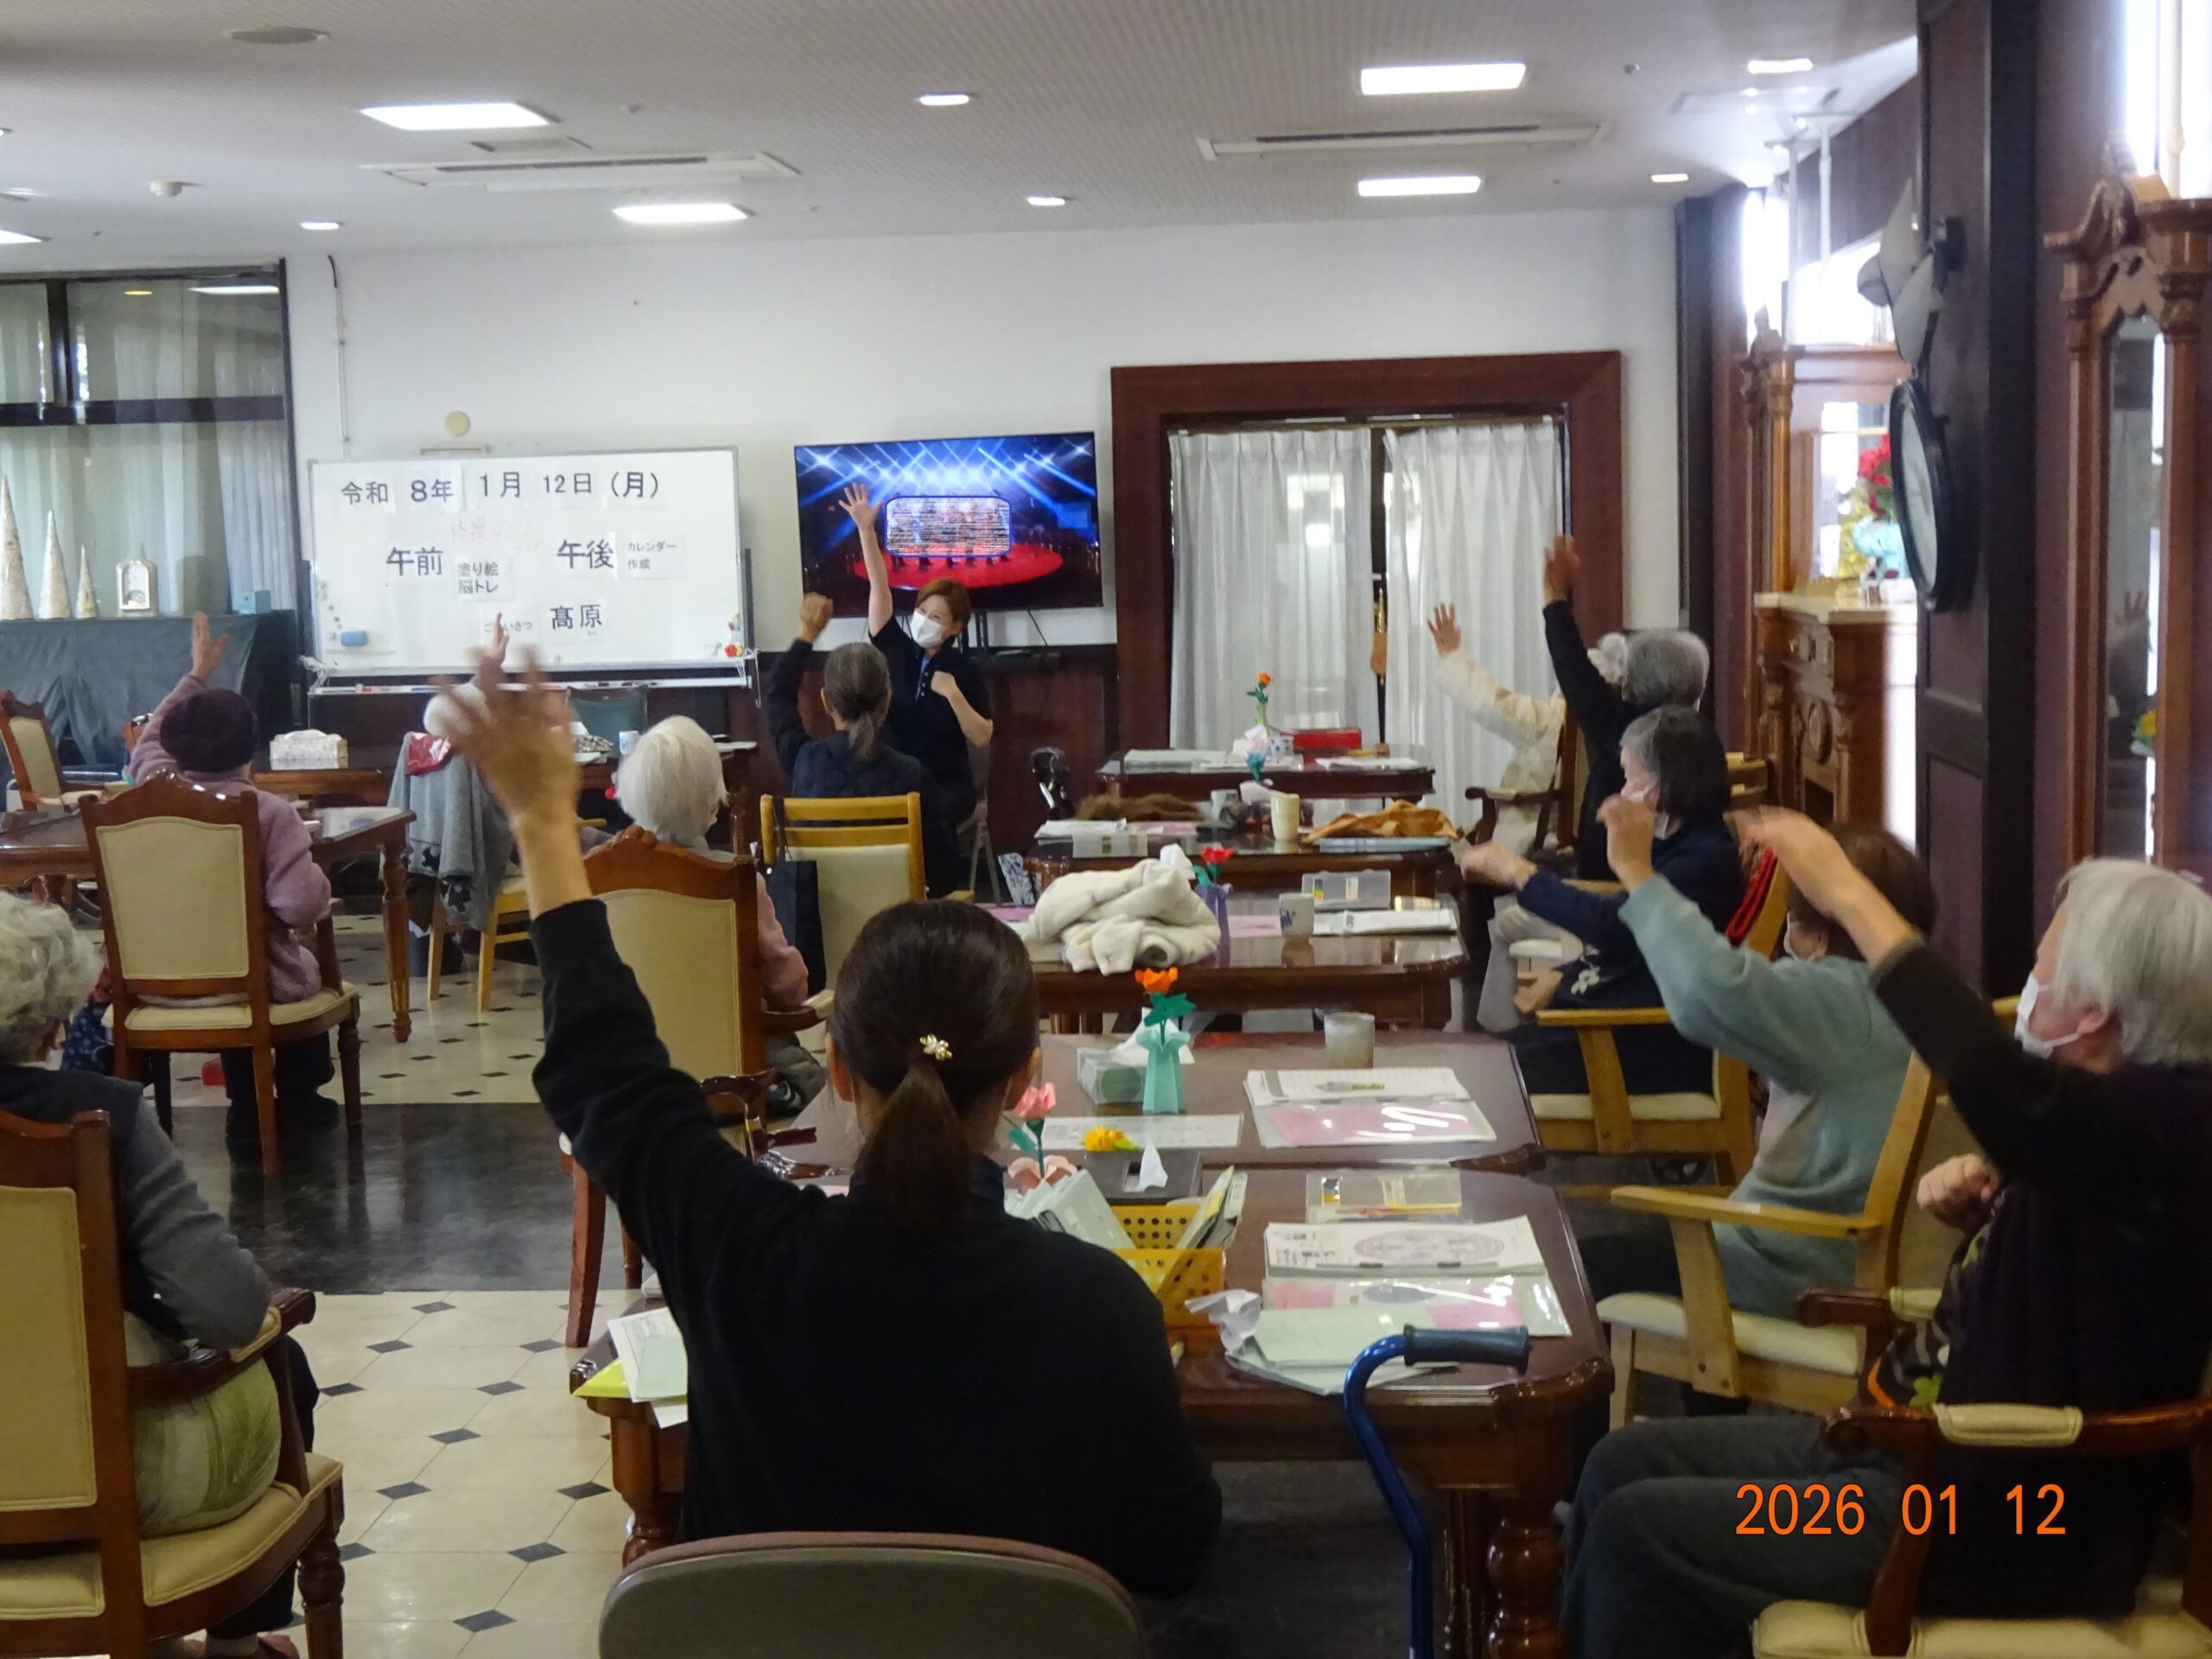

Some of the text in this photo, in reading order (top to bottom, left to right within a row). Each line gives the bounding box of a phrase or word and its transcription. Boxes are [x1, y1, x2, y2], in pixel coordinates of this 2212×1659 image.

[341, 471, 658, 505] 令和 8年 1月 12日 （月）
[627, 540, 677, 552] カレンダー
[386, 546, 444, 576] 午前
[556, 539, 614, 569] 午後
[457, 562, 499, 577] 塗り絵
[627, 558, 651, 570] 作成
[458, 579, 499, 594] 脳トレ
[484, 620, 533, 632] ごいさつ
